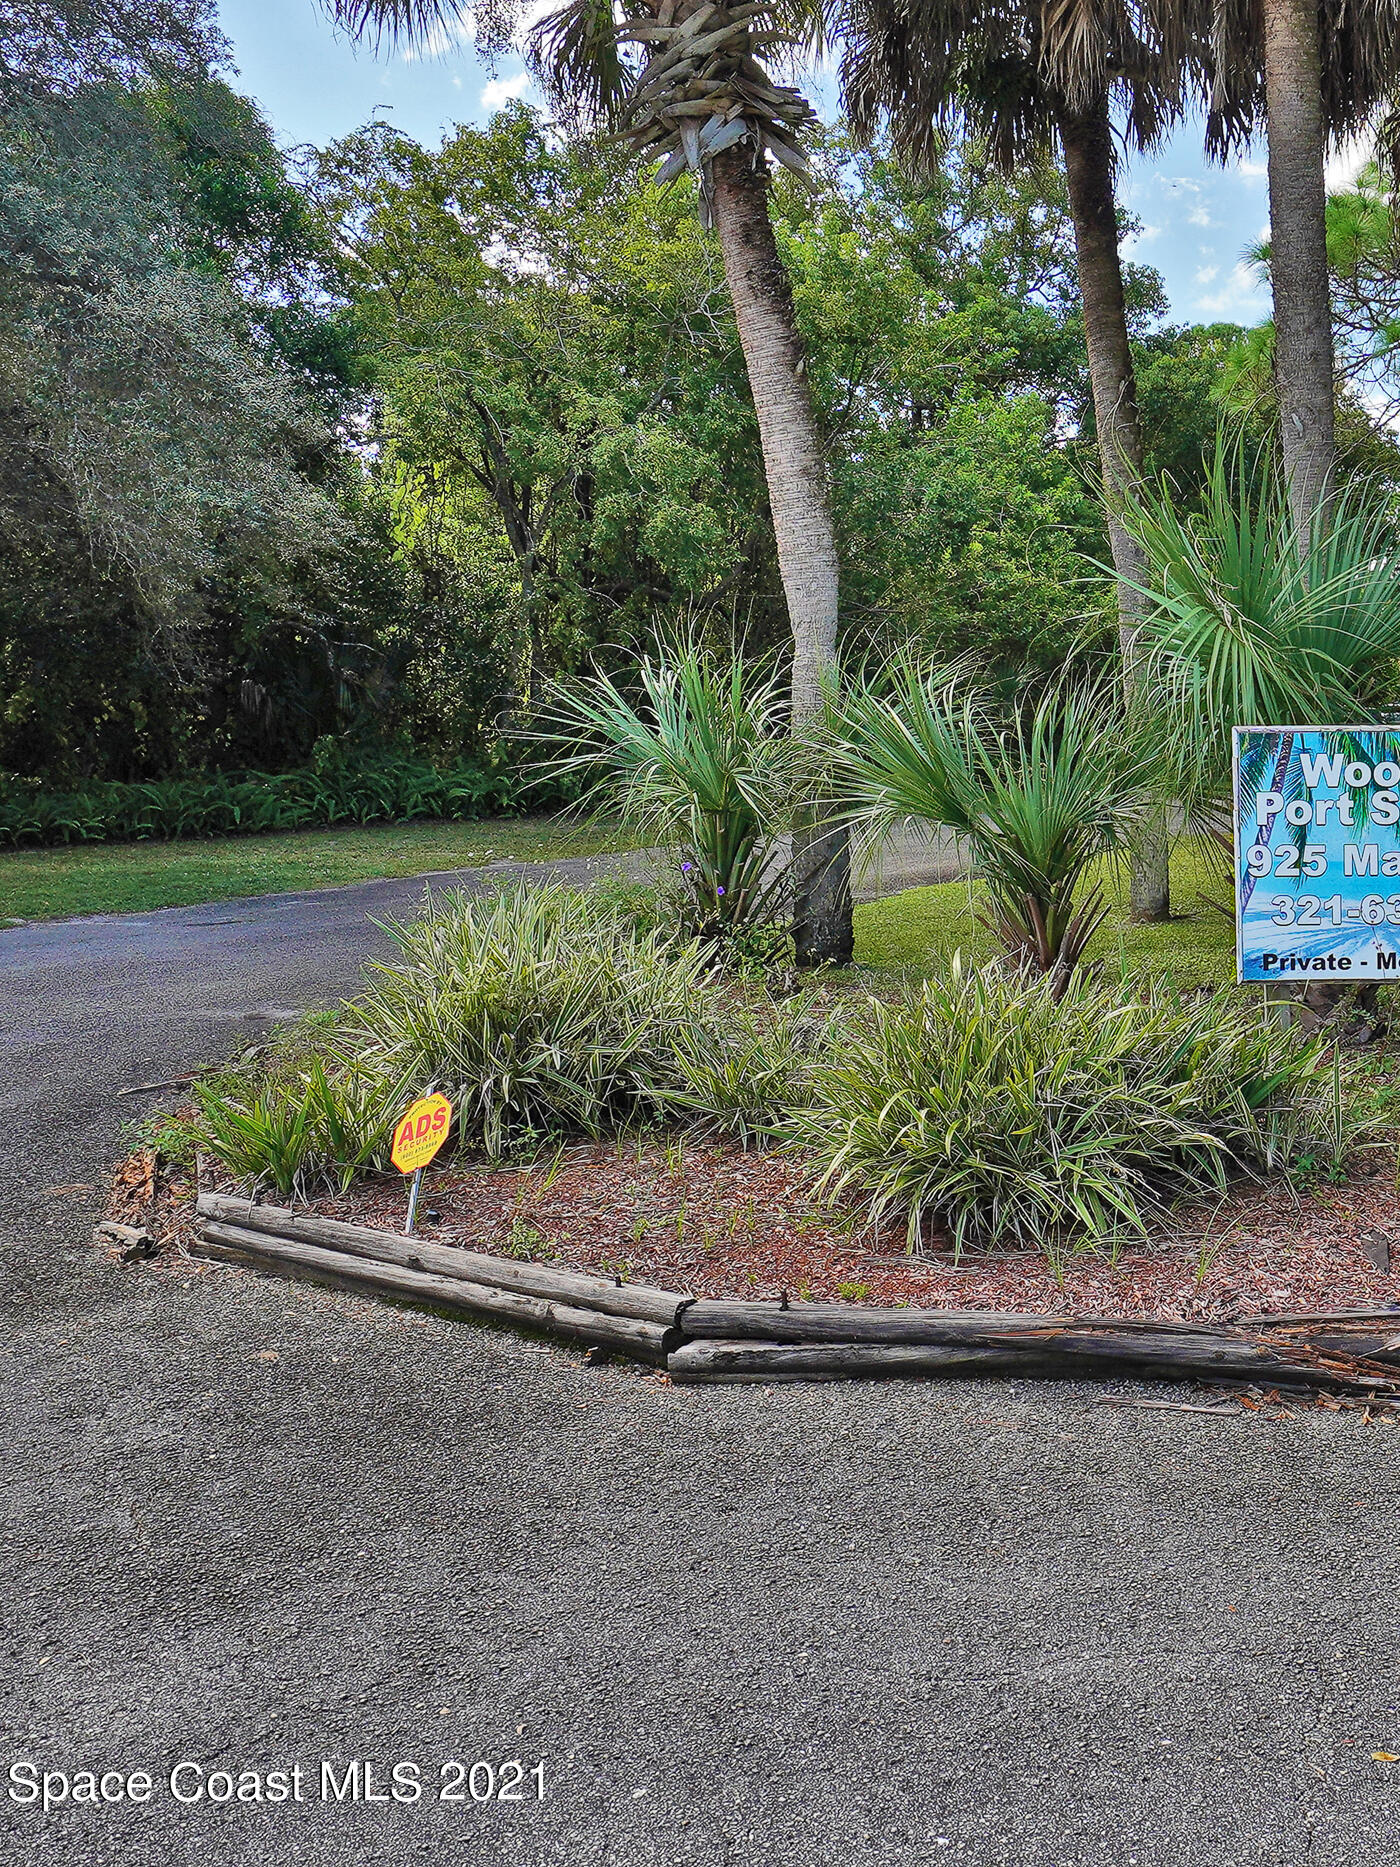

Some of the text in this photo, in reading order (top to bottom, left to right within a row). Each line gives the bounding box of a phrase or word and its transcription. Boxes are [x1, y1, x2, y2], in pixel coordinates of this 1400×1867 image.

[1255, 791, 1354, 826] Port
[1246, 843, 1327, 878] 925
[1262, 952, 1352, 971] Private
[397, 1106, 447, 1147] ADS
[397, 1129, 444, 1154] SECURITY
